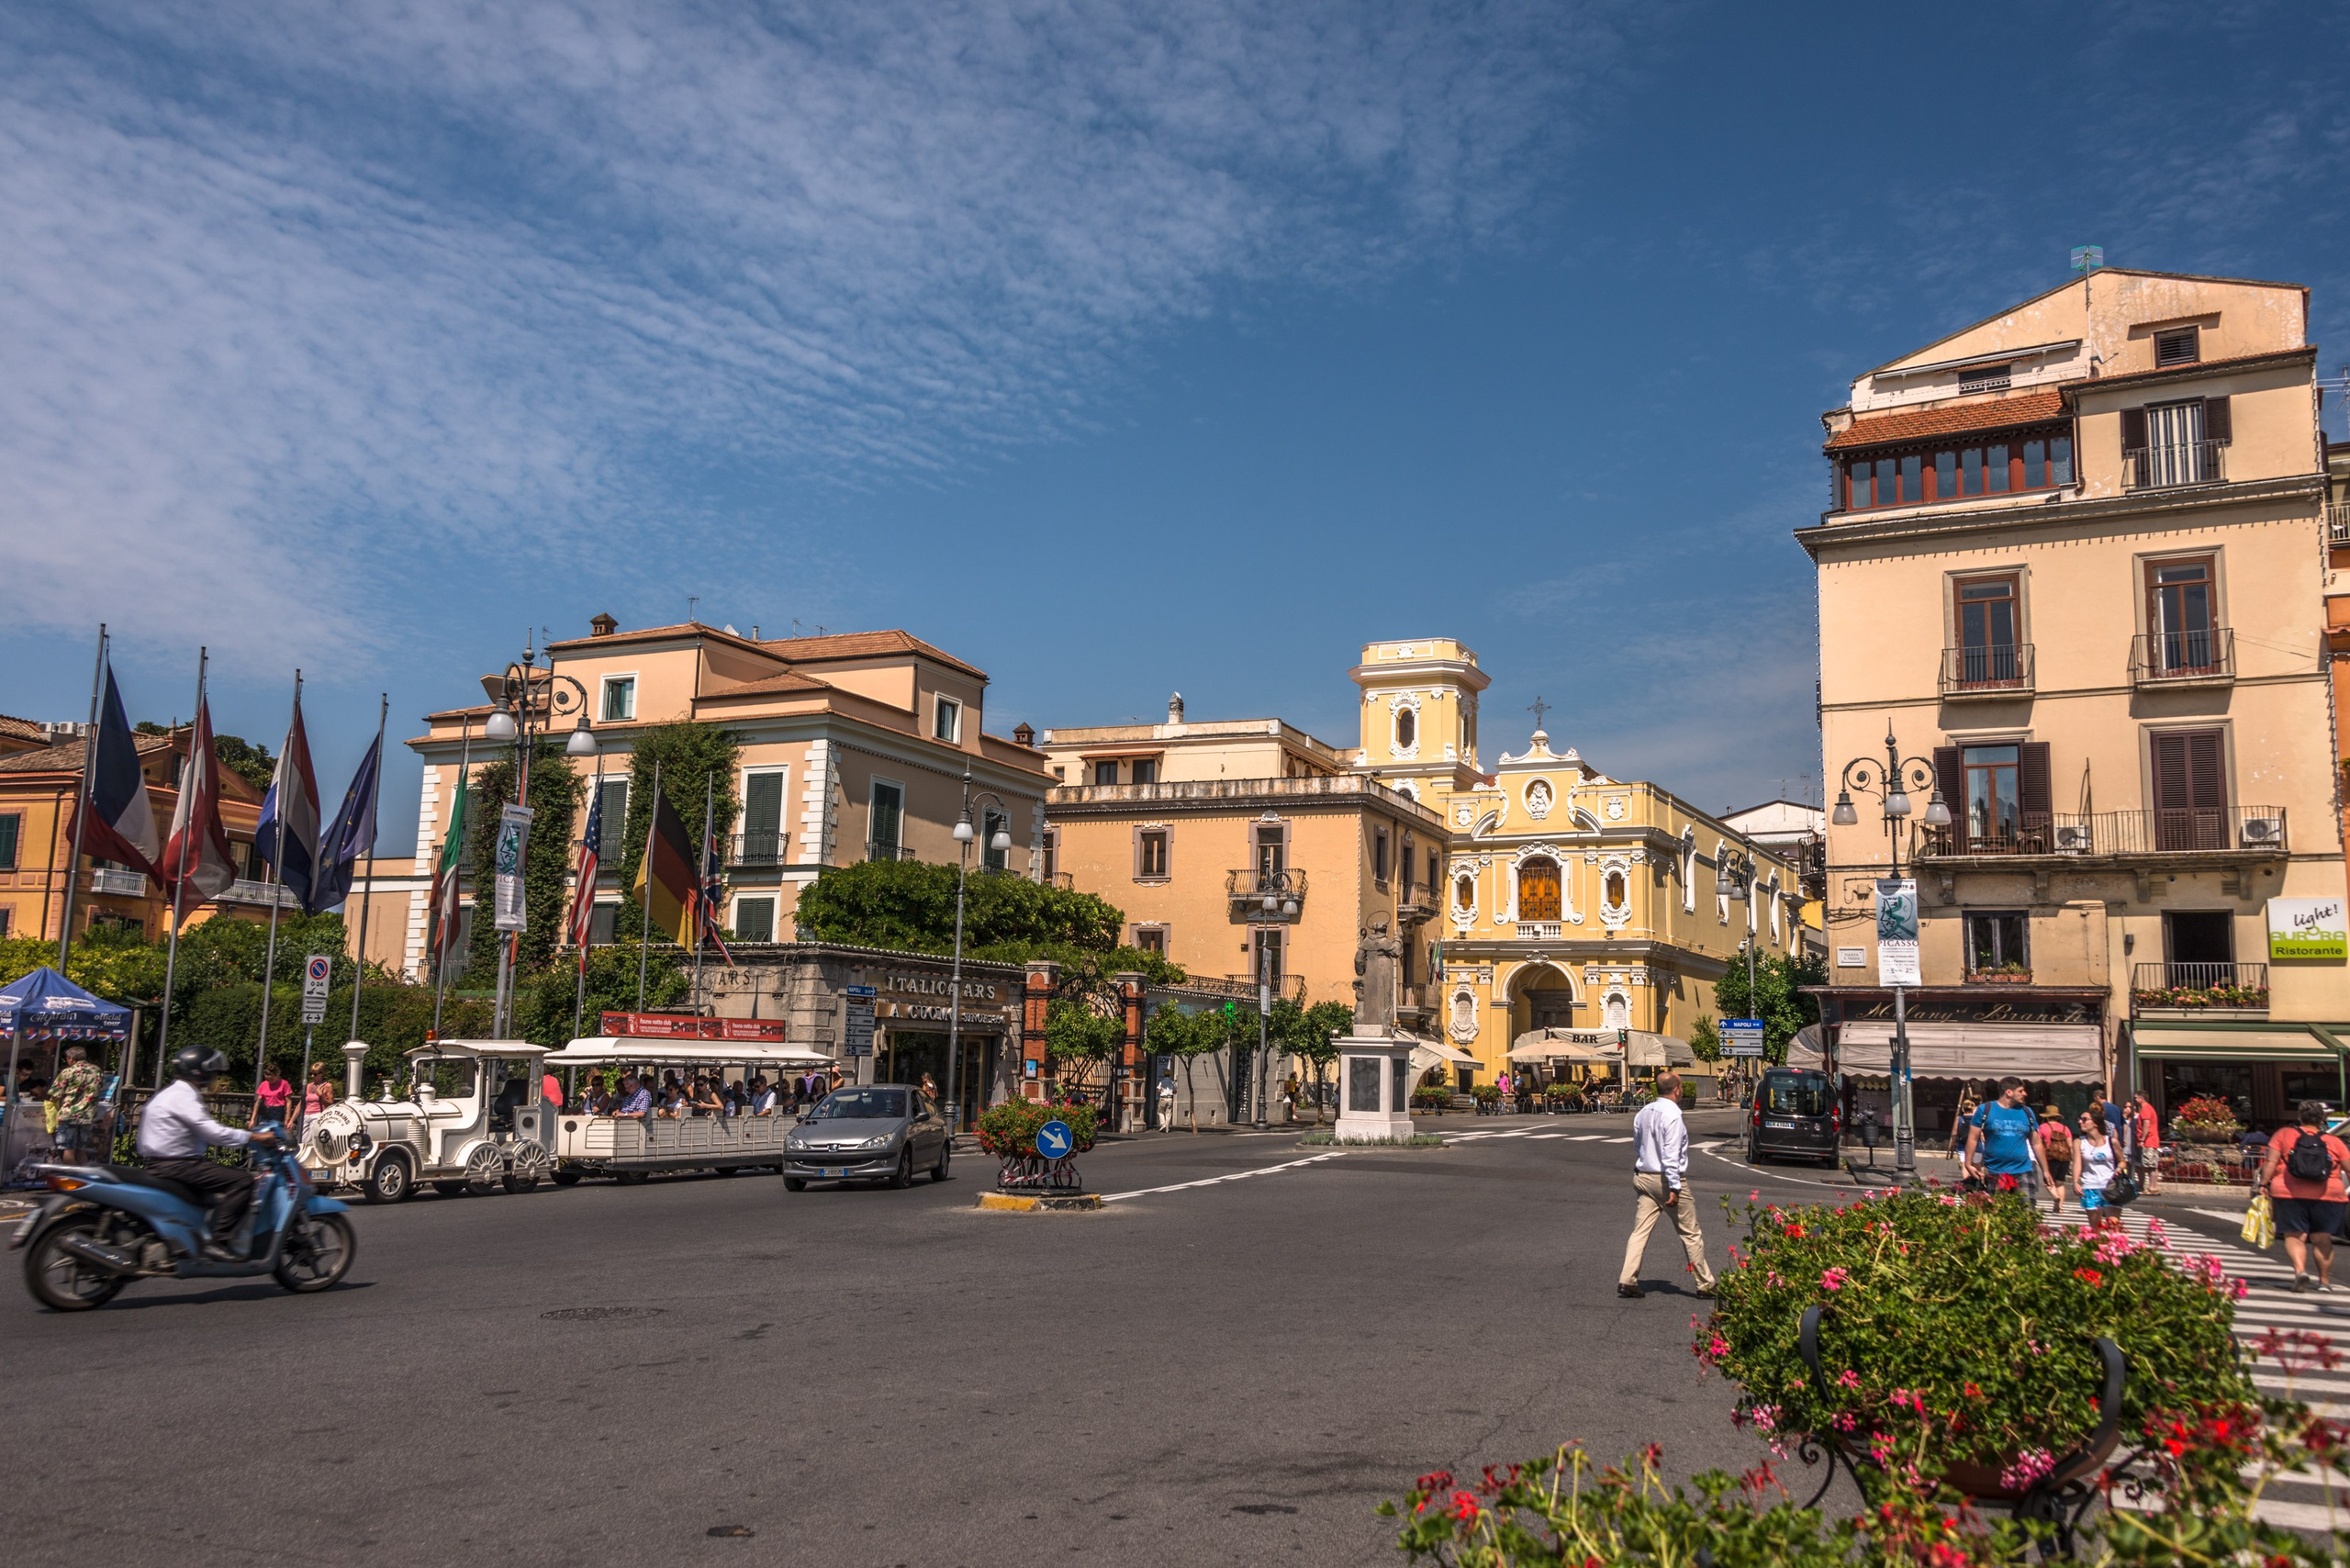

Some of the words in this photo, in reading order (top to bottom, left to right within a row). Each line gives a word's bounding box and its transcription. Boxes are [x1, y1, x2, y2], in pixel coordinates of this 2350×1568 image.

[2294, 903, 2339, 930] light!
[1878, 939, 1919, 947] PICASSO
[2276, 946, 2343, 955] Ristorante
[963, 982, 996, 999] ARS
[94, 1013, 122, 1021] official
[1572, 1034, 1599, 1044] BAR
